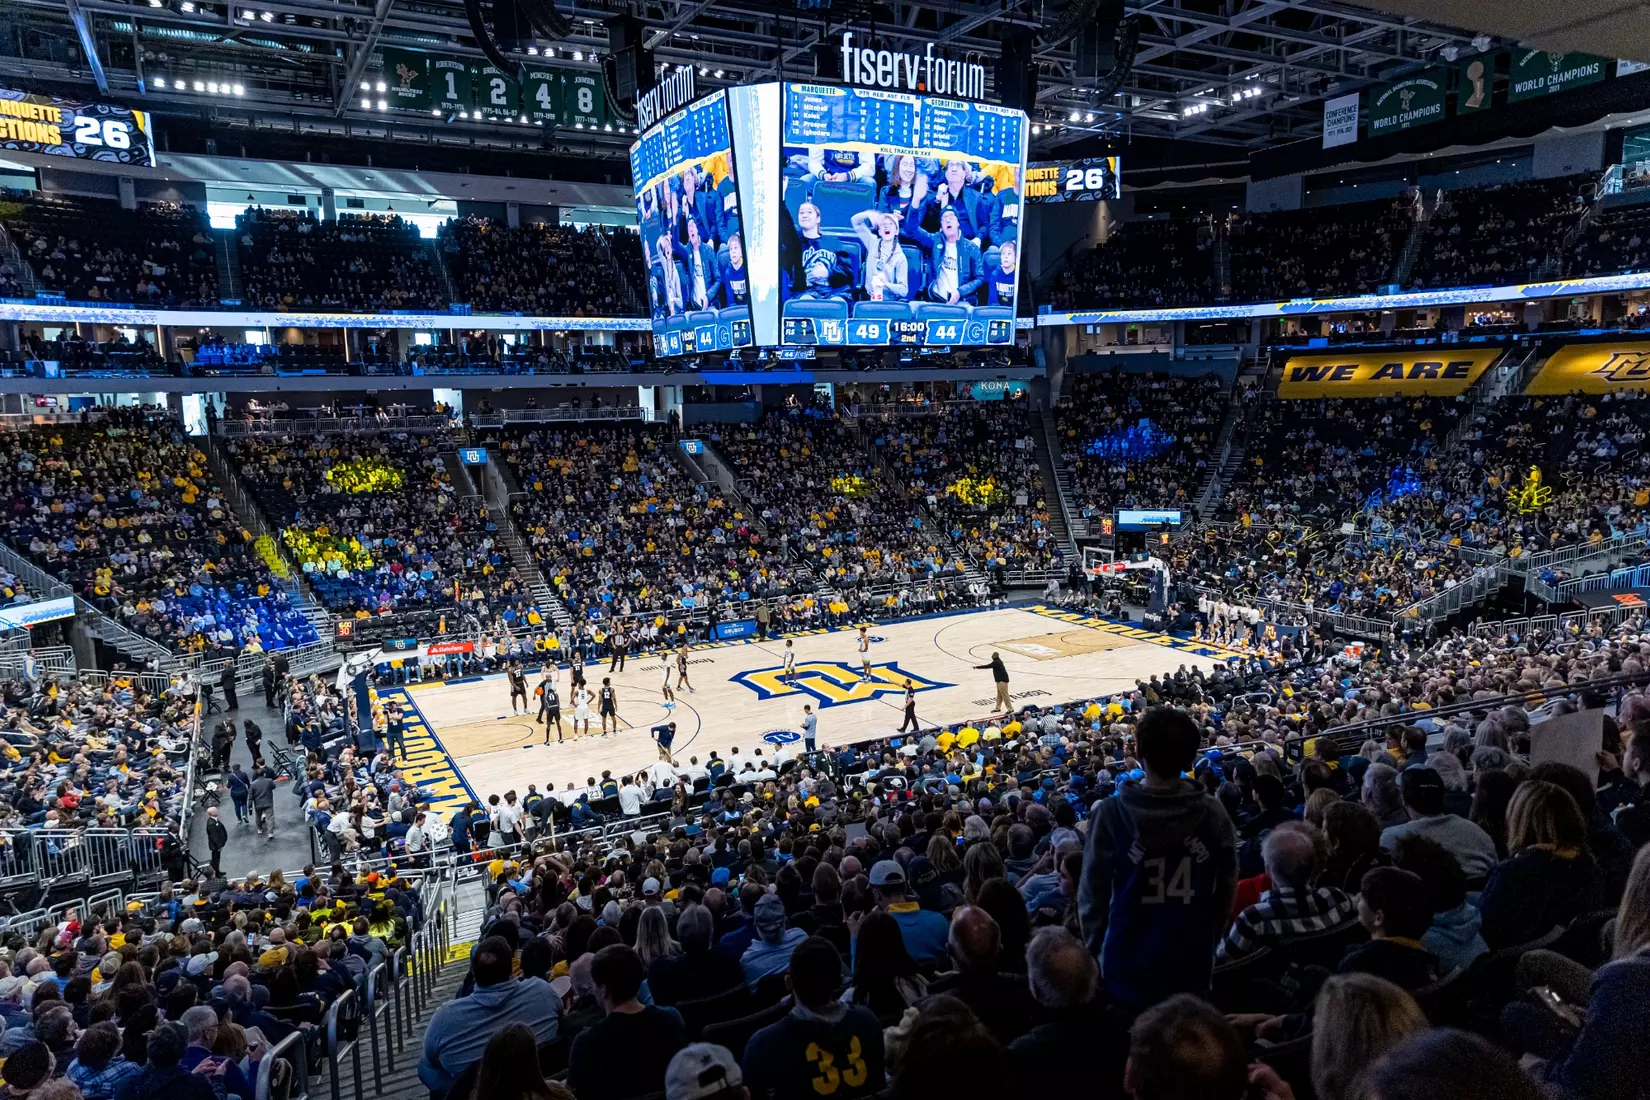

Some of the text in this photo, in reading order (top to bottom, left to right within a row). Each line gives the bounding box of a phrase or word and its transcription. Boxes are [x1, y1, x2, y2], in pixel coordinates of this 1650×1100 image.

[436, 61, 464, 71] ROBERTSON
[530, 72, 554, 81] MONCRIEF
[575, 77, 595, 85] JOHNSON
[1515, 77, 1544, 93] WORLD
[1547, 62, 1599, 85] CHAMPIONS
[446, 72, 457, 99] 1
[490, 78, 506, 105] 2
[802, 86, 836, 94] MARQUETTE
[536, 83, 551, 109] 4
[578, 87, 593, 113] 8
[932, 99, 964, 108] GEORGETOWN
[1326, 104, 1357, 119] CONFERENCE
[1374, 104, 1440, 129] WORLD CHAMPIONS
[1327, 114, 1355, 127] CHAMPIONS
[74, 115, 130, 149] 26
[1026, 167, 1059, 180] QUETTE
[1066, 168, 1103, 191] 26
[701, 332, 712, 346] 44
[718, 326, 730, 347] G
[856, 325, 880, 339] 49
[936, 326, 956, 339] 44
[968, 322, 984, 343] G
[1289, 361, 1474, 382] WE ARE
[981, 381, 1010, 390] KONA
[686, 441, 697, 453] MU
[466, 451, 480, 463] MU
[1103, 526, 1111, 534] 30
[395, 640, 406, 649] MU
[1142, 856, 1195, 904] 34
[805, 1035, 868, 1095] 33
